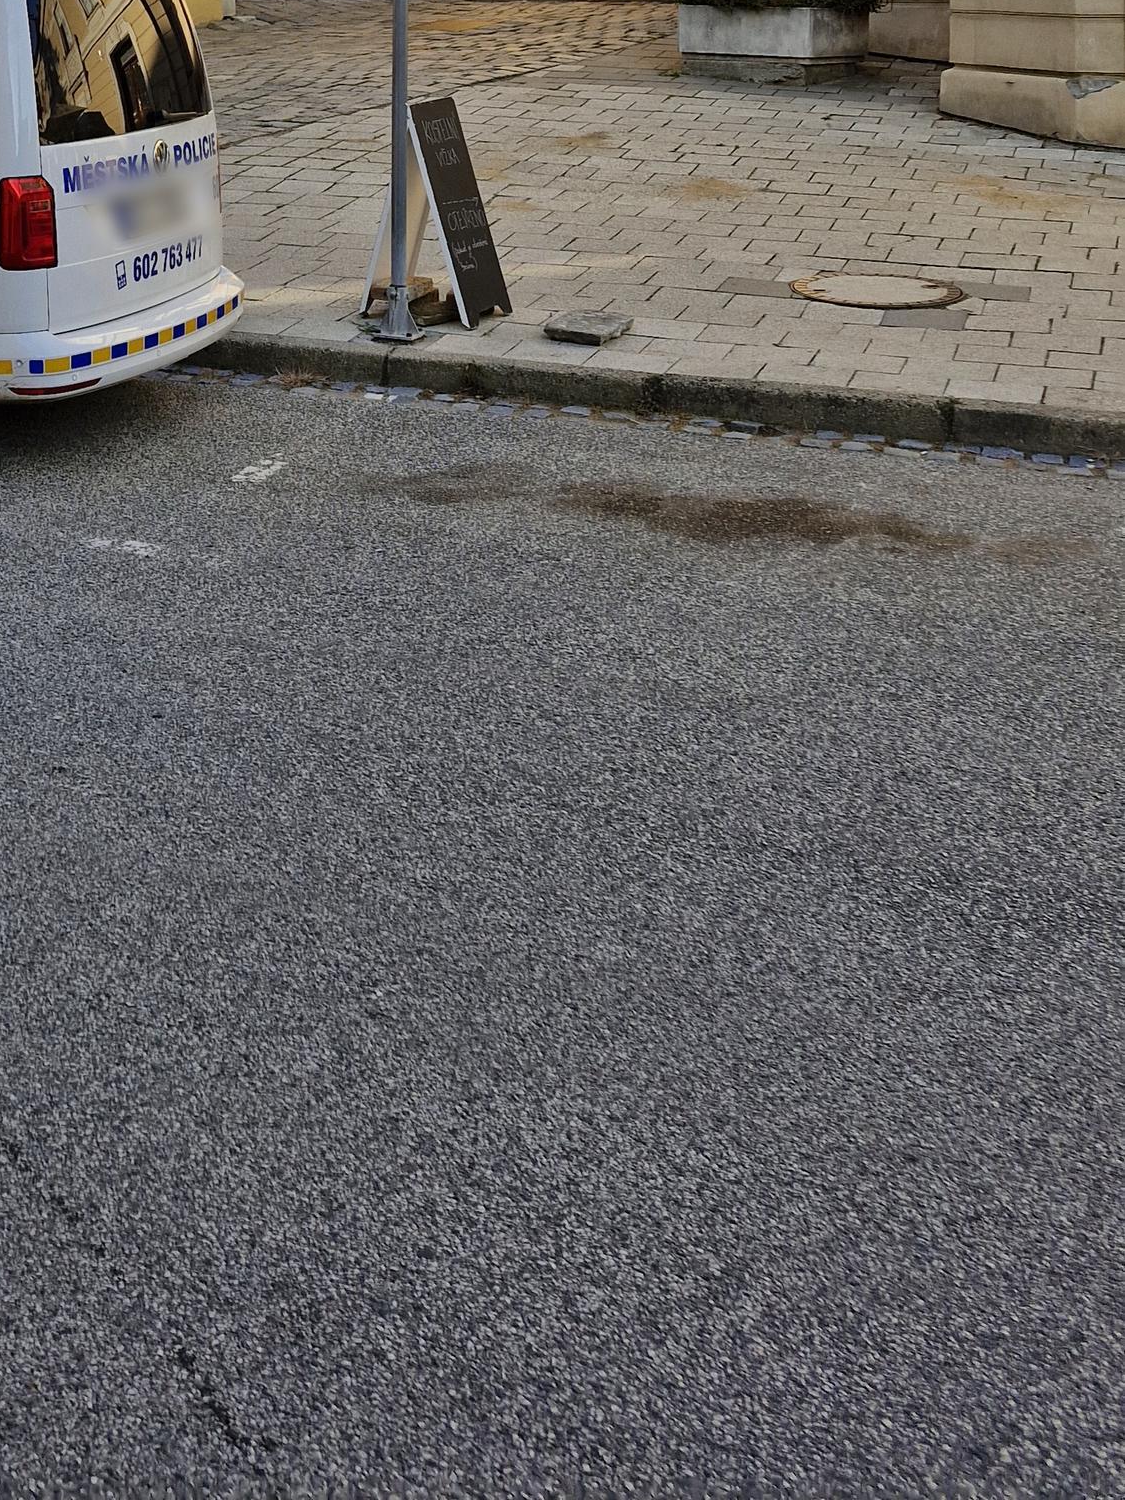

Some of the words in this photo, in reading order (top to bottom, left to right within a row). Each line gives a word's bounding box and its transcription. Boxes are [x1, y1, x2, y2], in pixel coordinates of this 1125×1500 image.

[173, 132, 216, 168] POLICIE
[133, 251, 159, 282] 602
[162, 242, 183, 273] 763
[185, 235, 203, 264] 477
